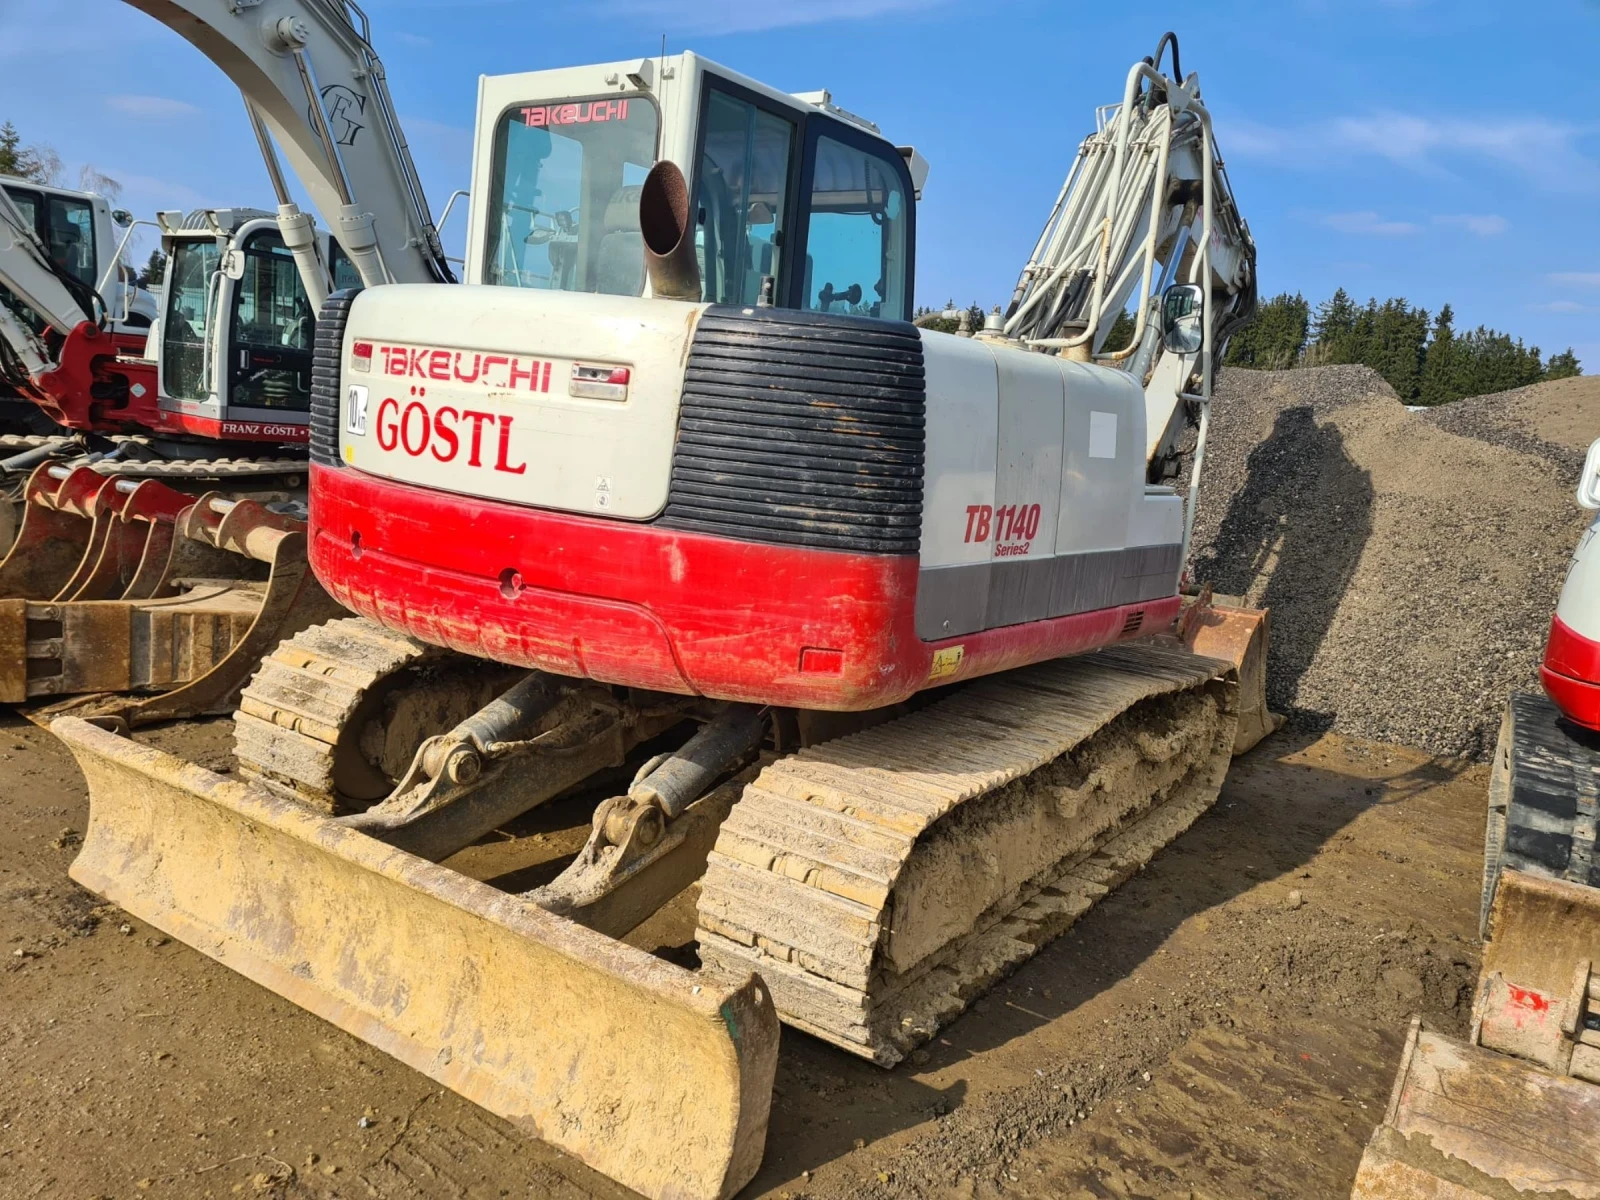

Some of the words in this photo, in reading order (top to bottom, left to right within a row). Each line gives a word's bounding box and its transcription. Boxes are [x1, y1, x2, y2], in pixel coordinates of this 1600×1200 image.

[520, 99, 628, 126] TAKEUCHI
[380, 346, 552, 393] TAKEUCHI
[222, 423, 259, 435] FRANZ
[263, 424, 298, 437] GÖSTL
[376, 385, 526, 474] GÖSTL
[964, 503, 1041, 543] TB1140
[995, 541, 1030, 557] Series2
